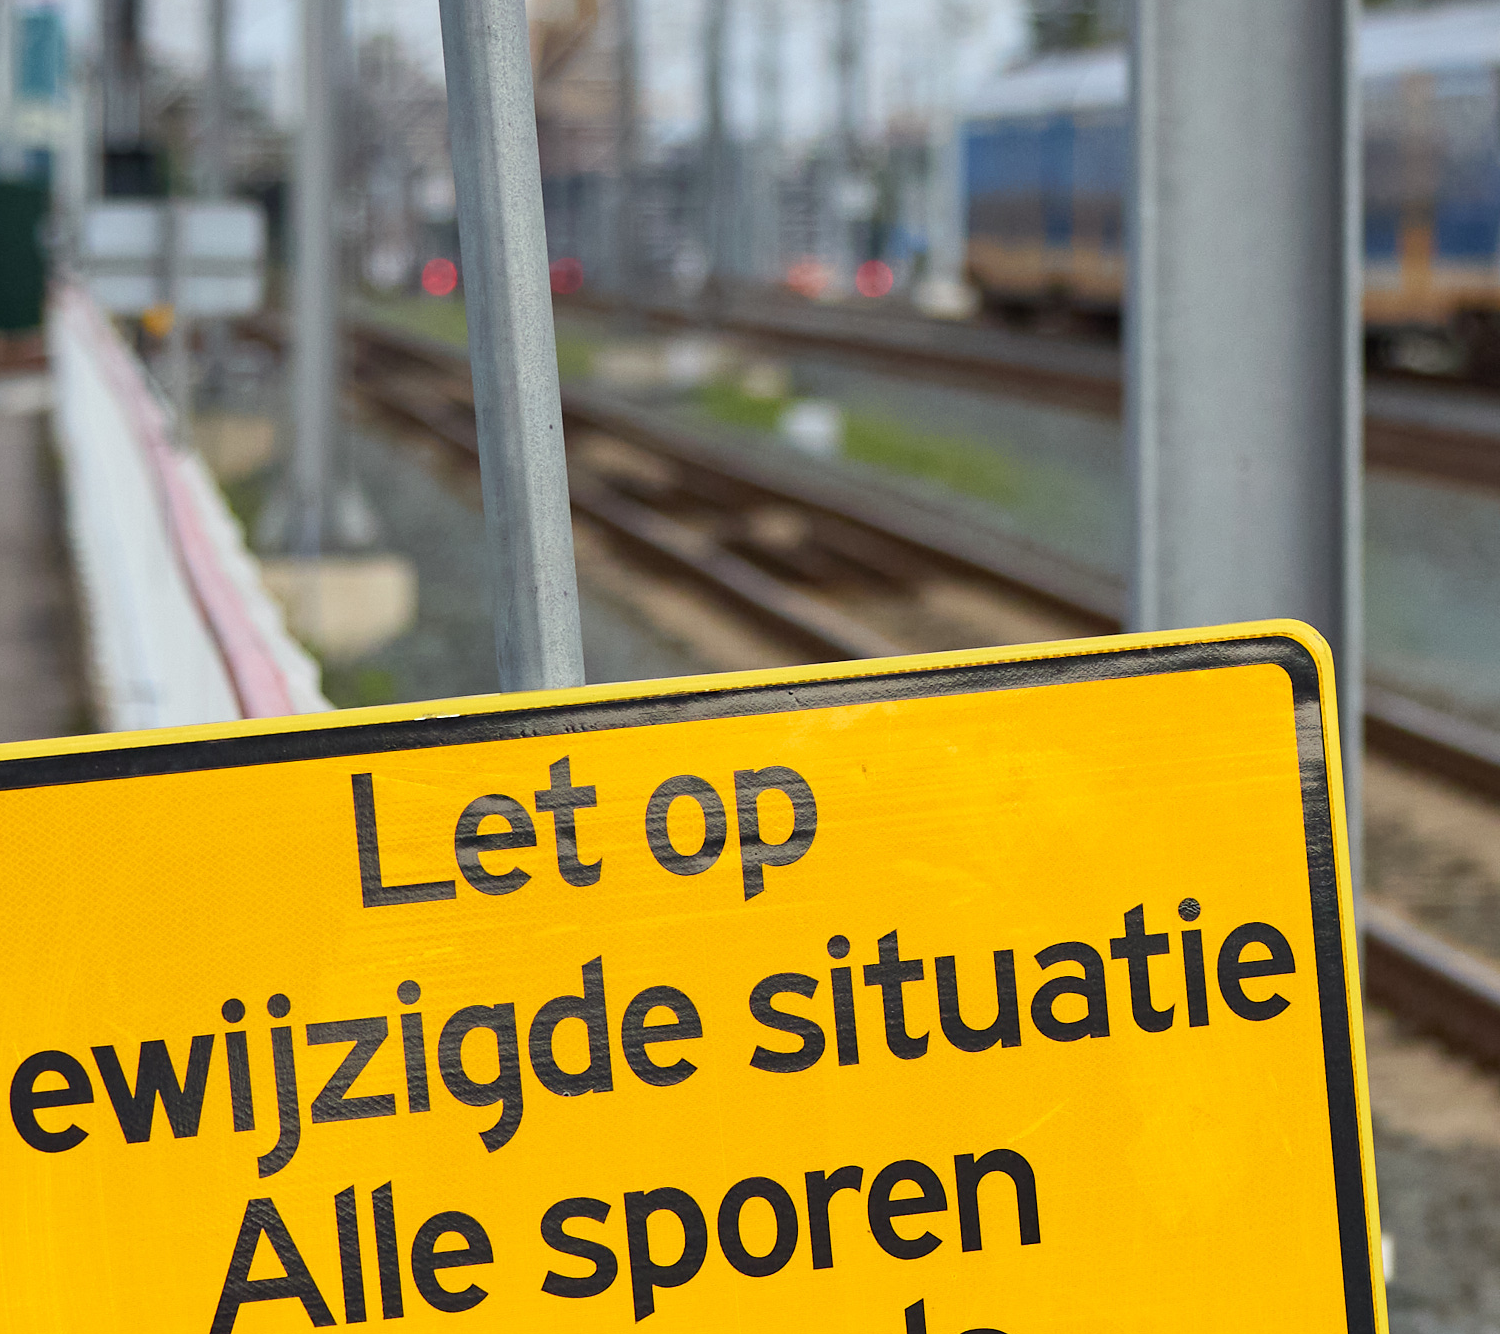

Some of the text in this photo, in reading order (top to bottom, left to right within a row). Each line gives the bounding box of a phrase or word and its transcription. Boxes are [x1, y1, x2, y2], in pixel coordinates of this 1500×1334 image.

[352, 757, 817, 907] Let op
[750, 898, 1295, 1073] situatie
[541, 1149, 1041, 1322] sporen
